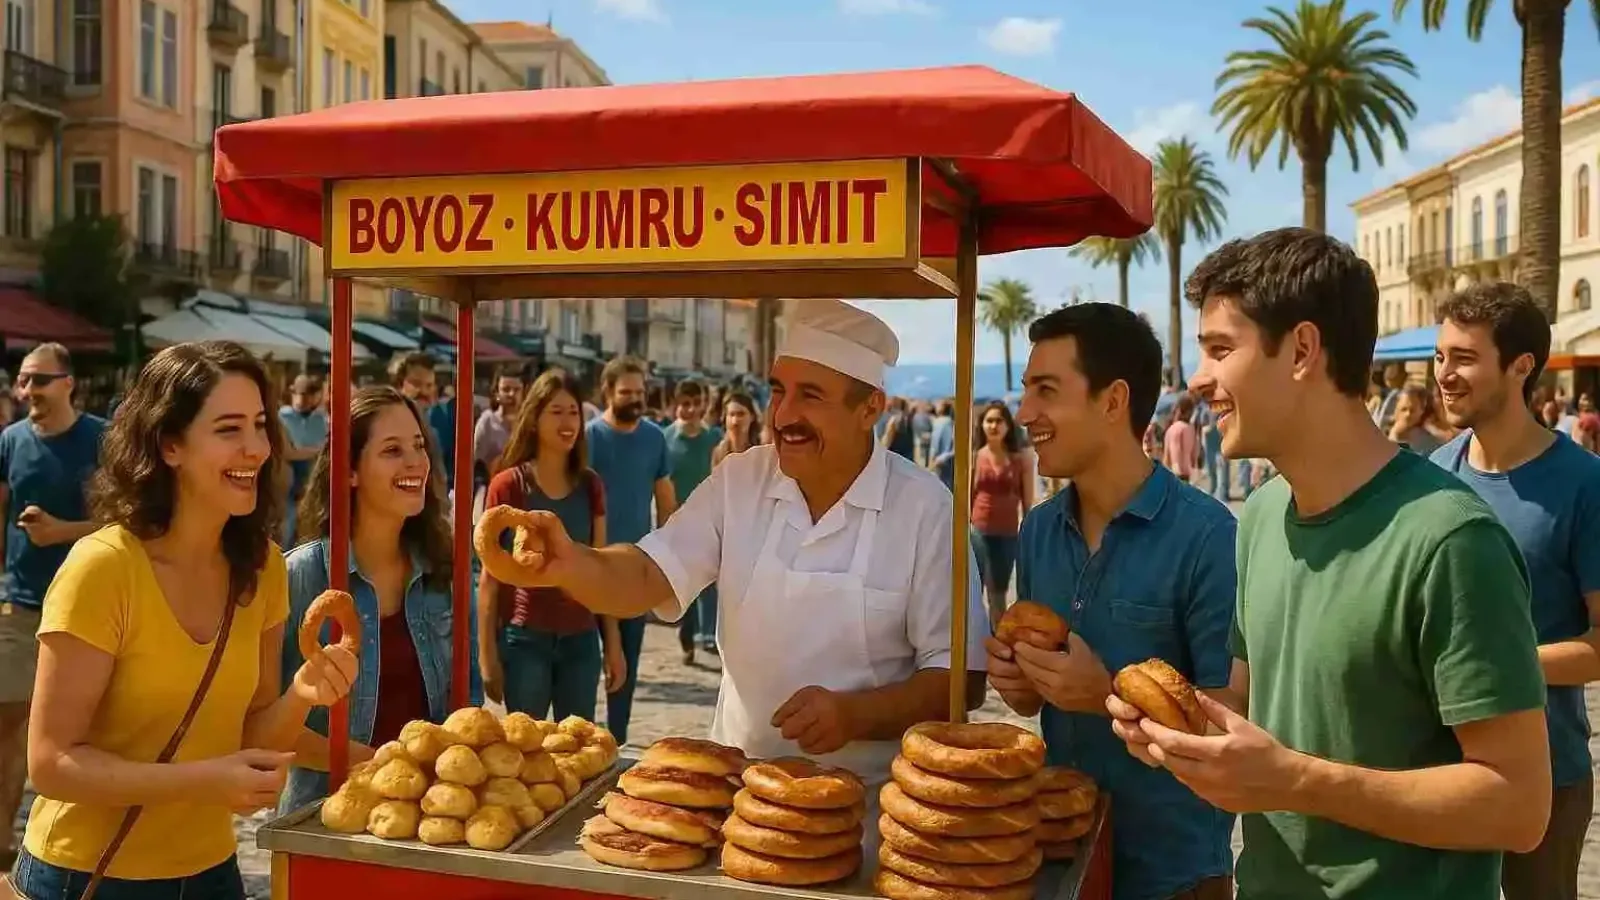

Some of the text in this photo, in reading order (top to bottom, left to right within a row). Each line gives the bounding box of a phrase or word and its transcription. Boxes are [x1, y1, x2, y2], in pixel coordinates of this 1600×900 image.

[349, 179, 887, 253] BOYOZ KUMRU SIMIT
